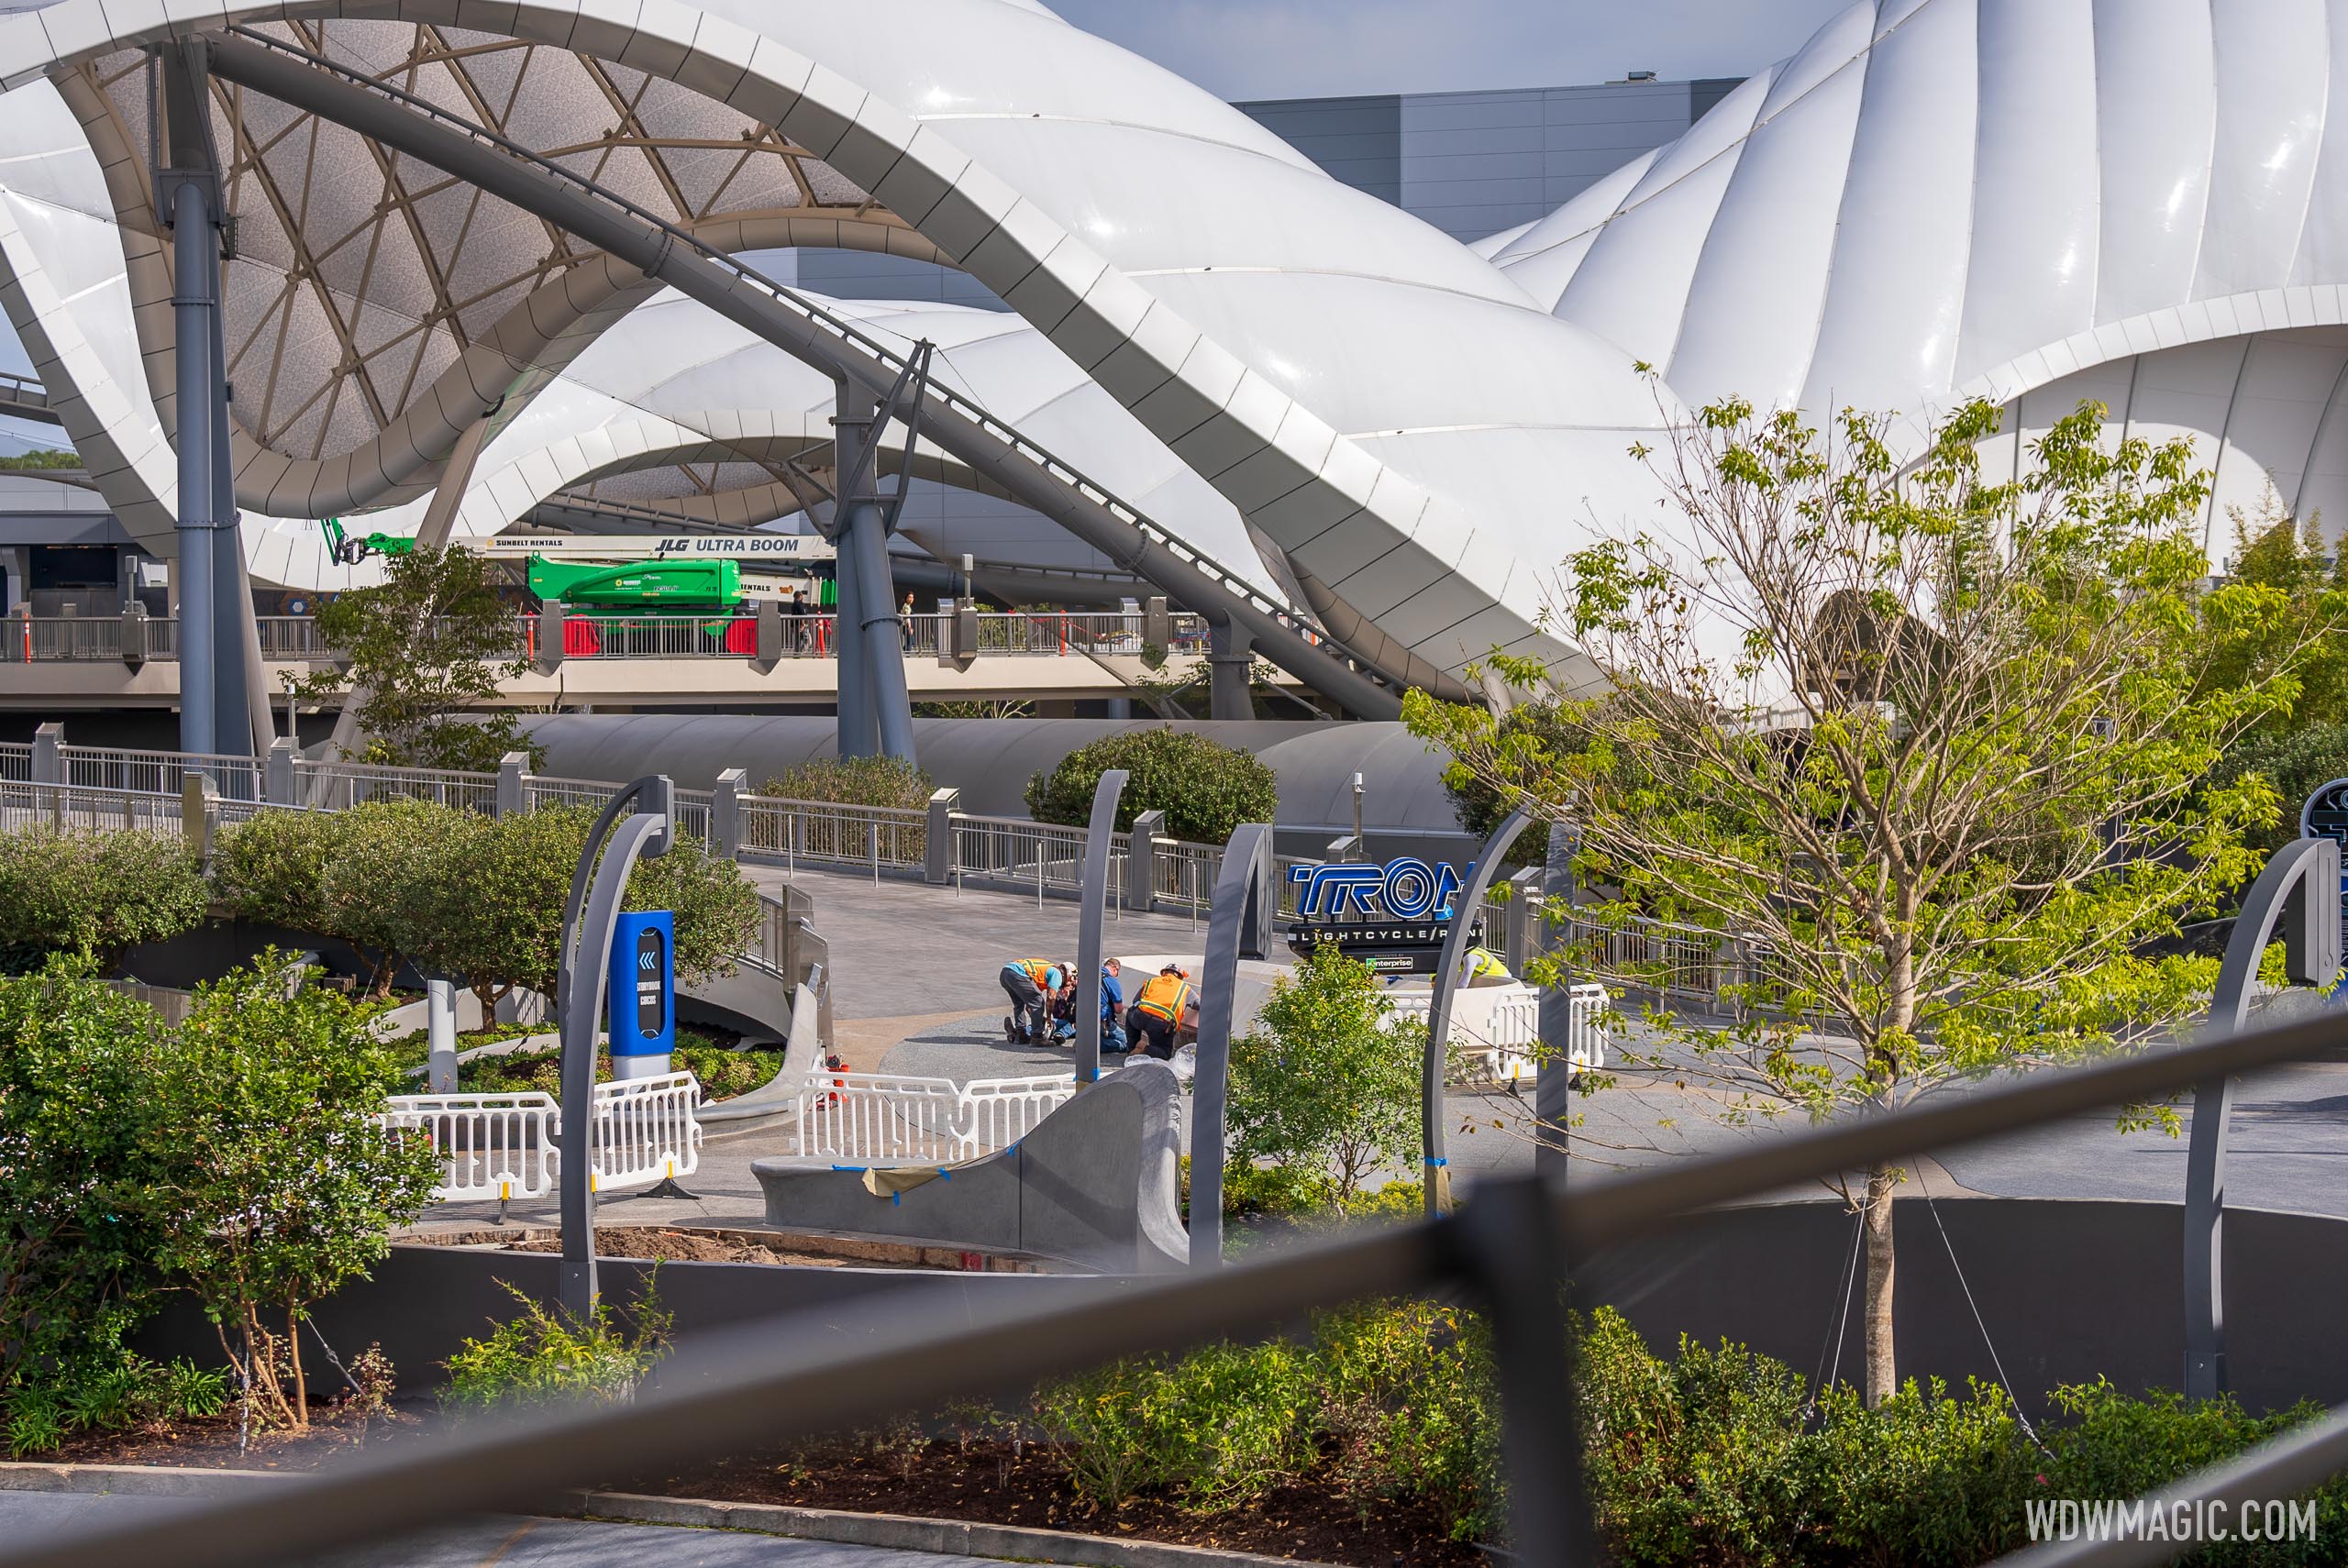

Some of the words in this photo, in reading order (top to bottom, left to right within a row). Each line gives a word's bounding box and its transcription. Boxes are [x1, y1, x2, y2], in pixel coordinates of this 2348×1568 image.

[655, 539, 690, 552] JLG
[696, 539, 744, 551] ULTRA
[749, 539, 799, 551] BOOM
